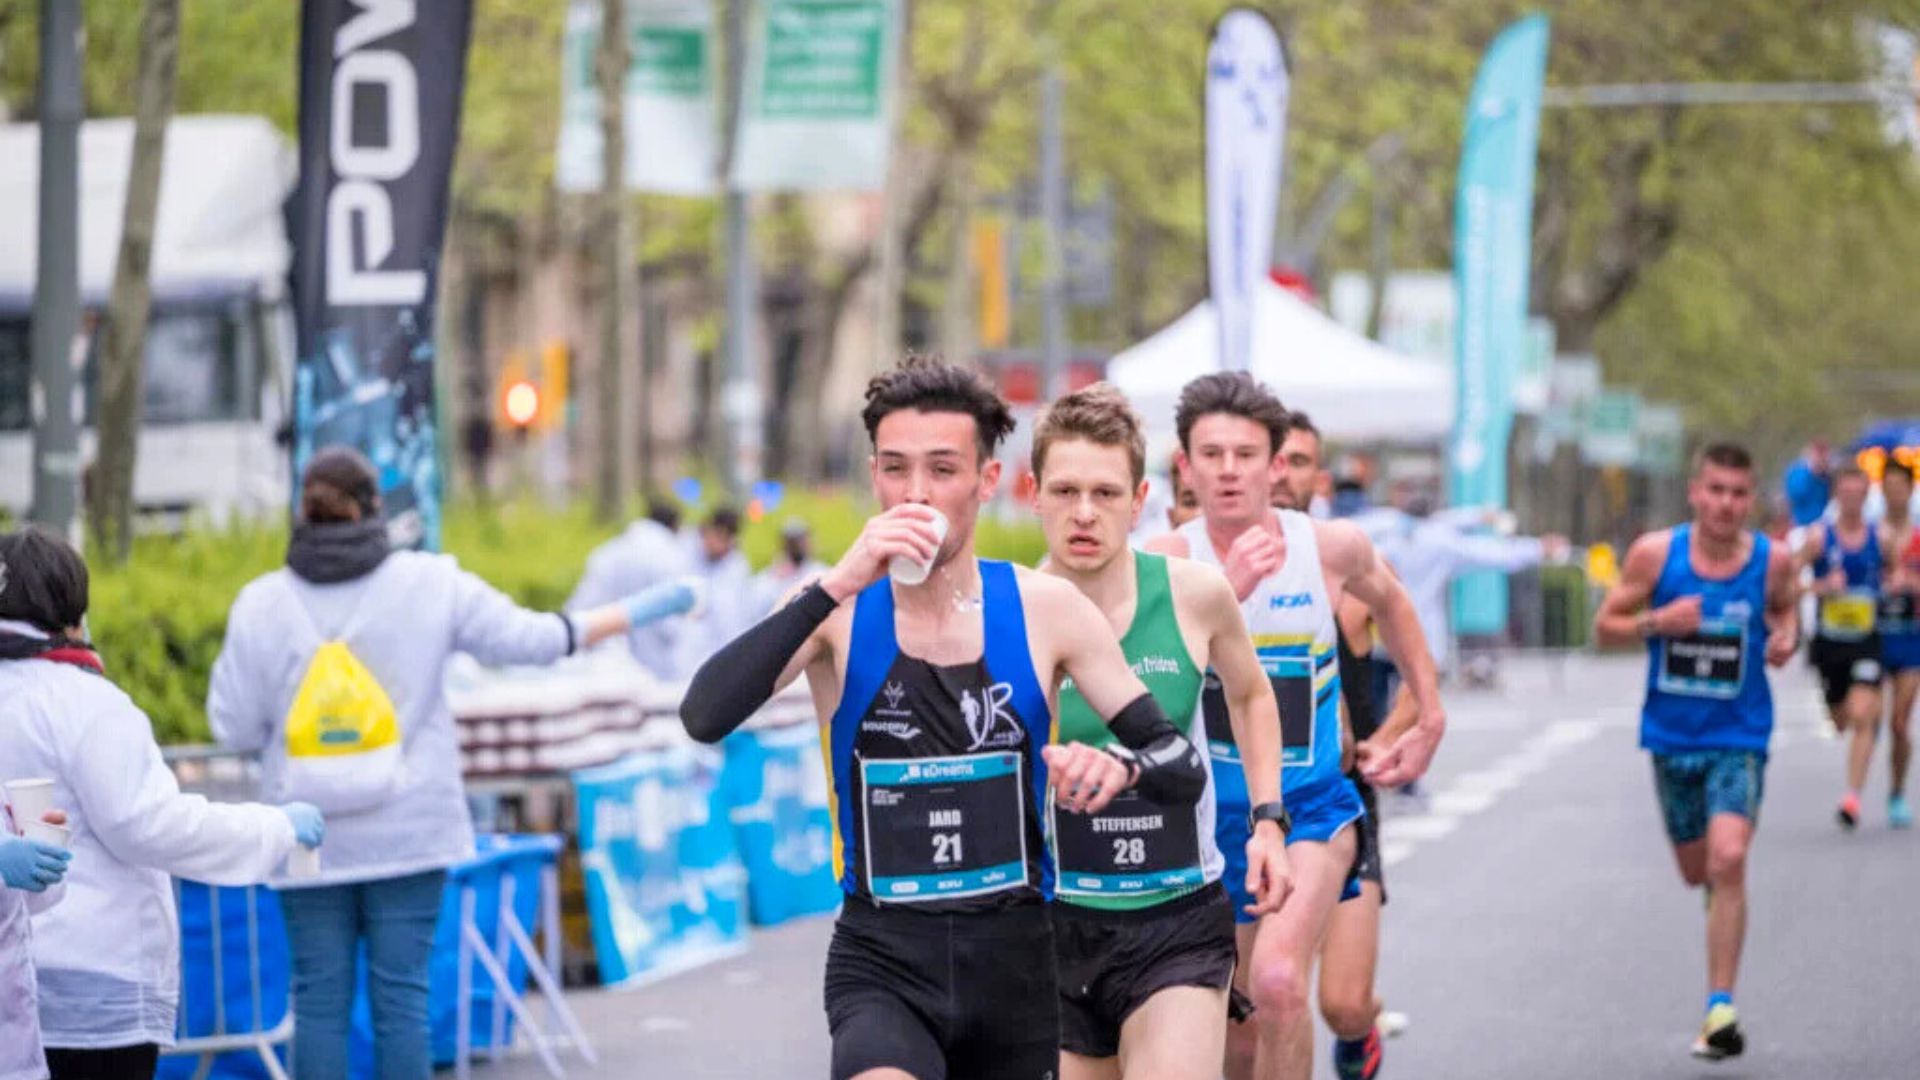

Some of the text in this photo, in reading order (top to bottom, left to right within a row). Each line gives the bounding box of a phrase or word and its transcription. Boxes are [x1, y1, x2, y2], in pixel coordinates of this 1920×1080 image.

[922, 763, 974, 778] eDreams
[1091, 815, 1164, 832] STEFFENSEN
[932, 833, 963, 864] 21
[1113, 837, 1146, 865] 28
